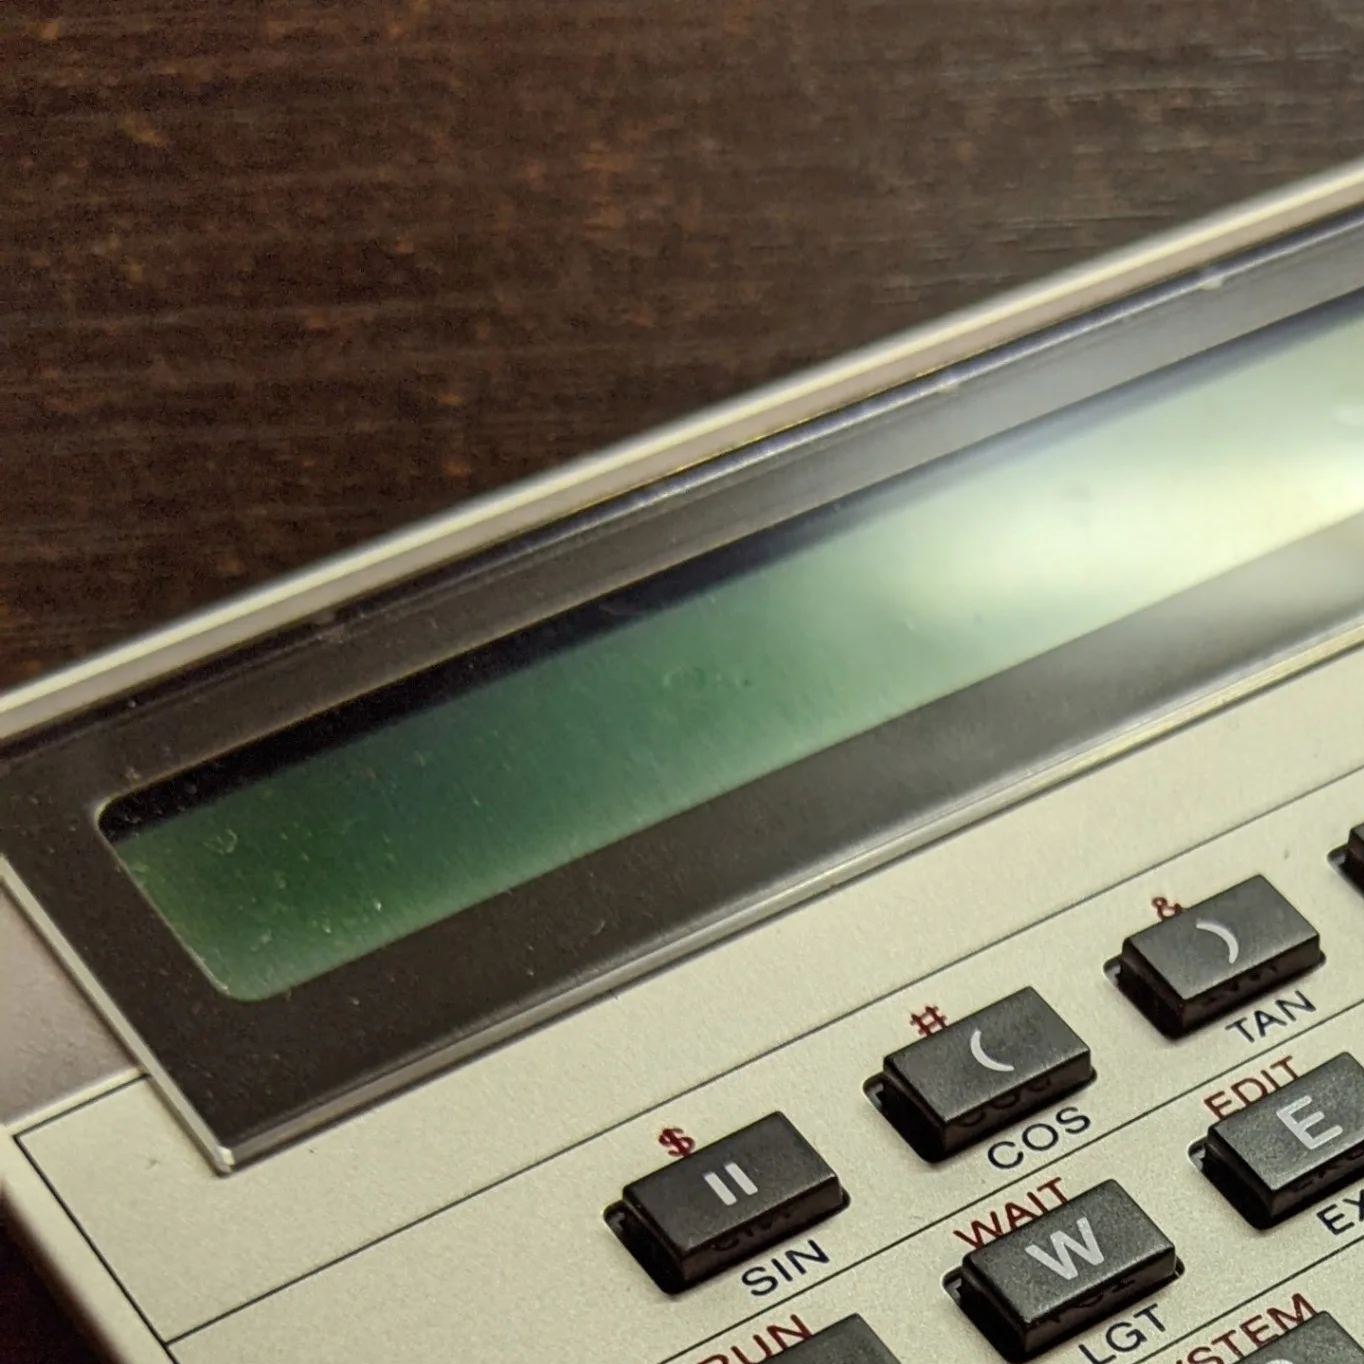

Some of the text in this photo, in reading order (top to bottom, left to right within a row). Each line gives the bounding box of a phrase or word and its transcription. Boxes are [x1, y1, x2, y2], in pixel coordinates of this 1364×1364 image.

[1225, 990, 1318, 1047] TAN
[1204, 1057, 1302, 1119] EDIT
[986, 1105, 1092, 1172] COS
[1276, 1096, 1345, 1152] E
[954, 1178, 1072, 1249] WAIT
[740, 1238, 832, 1297] SIN
[1024, 1219, 1106, 1280] W
